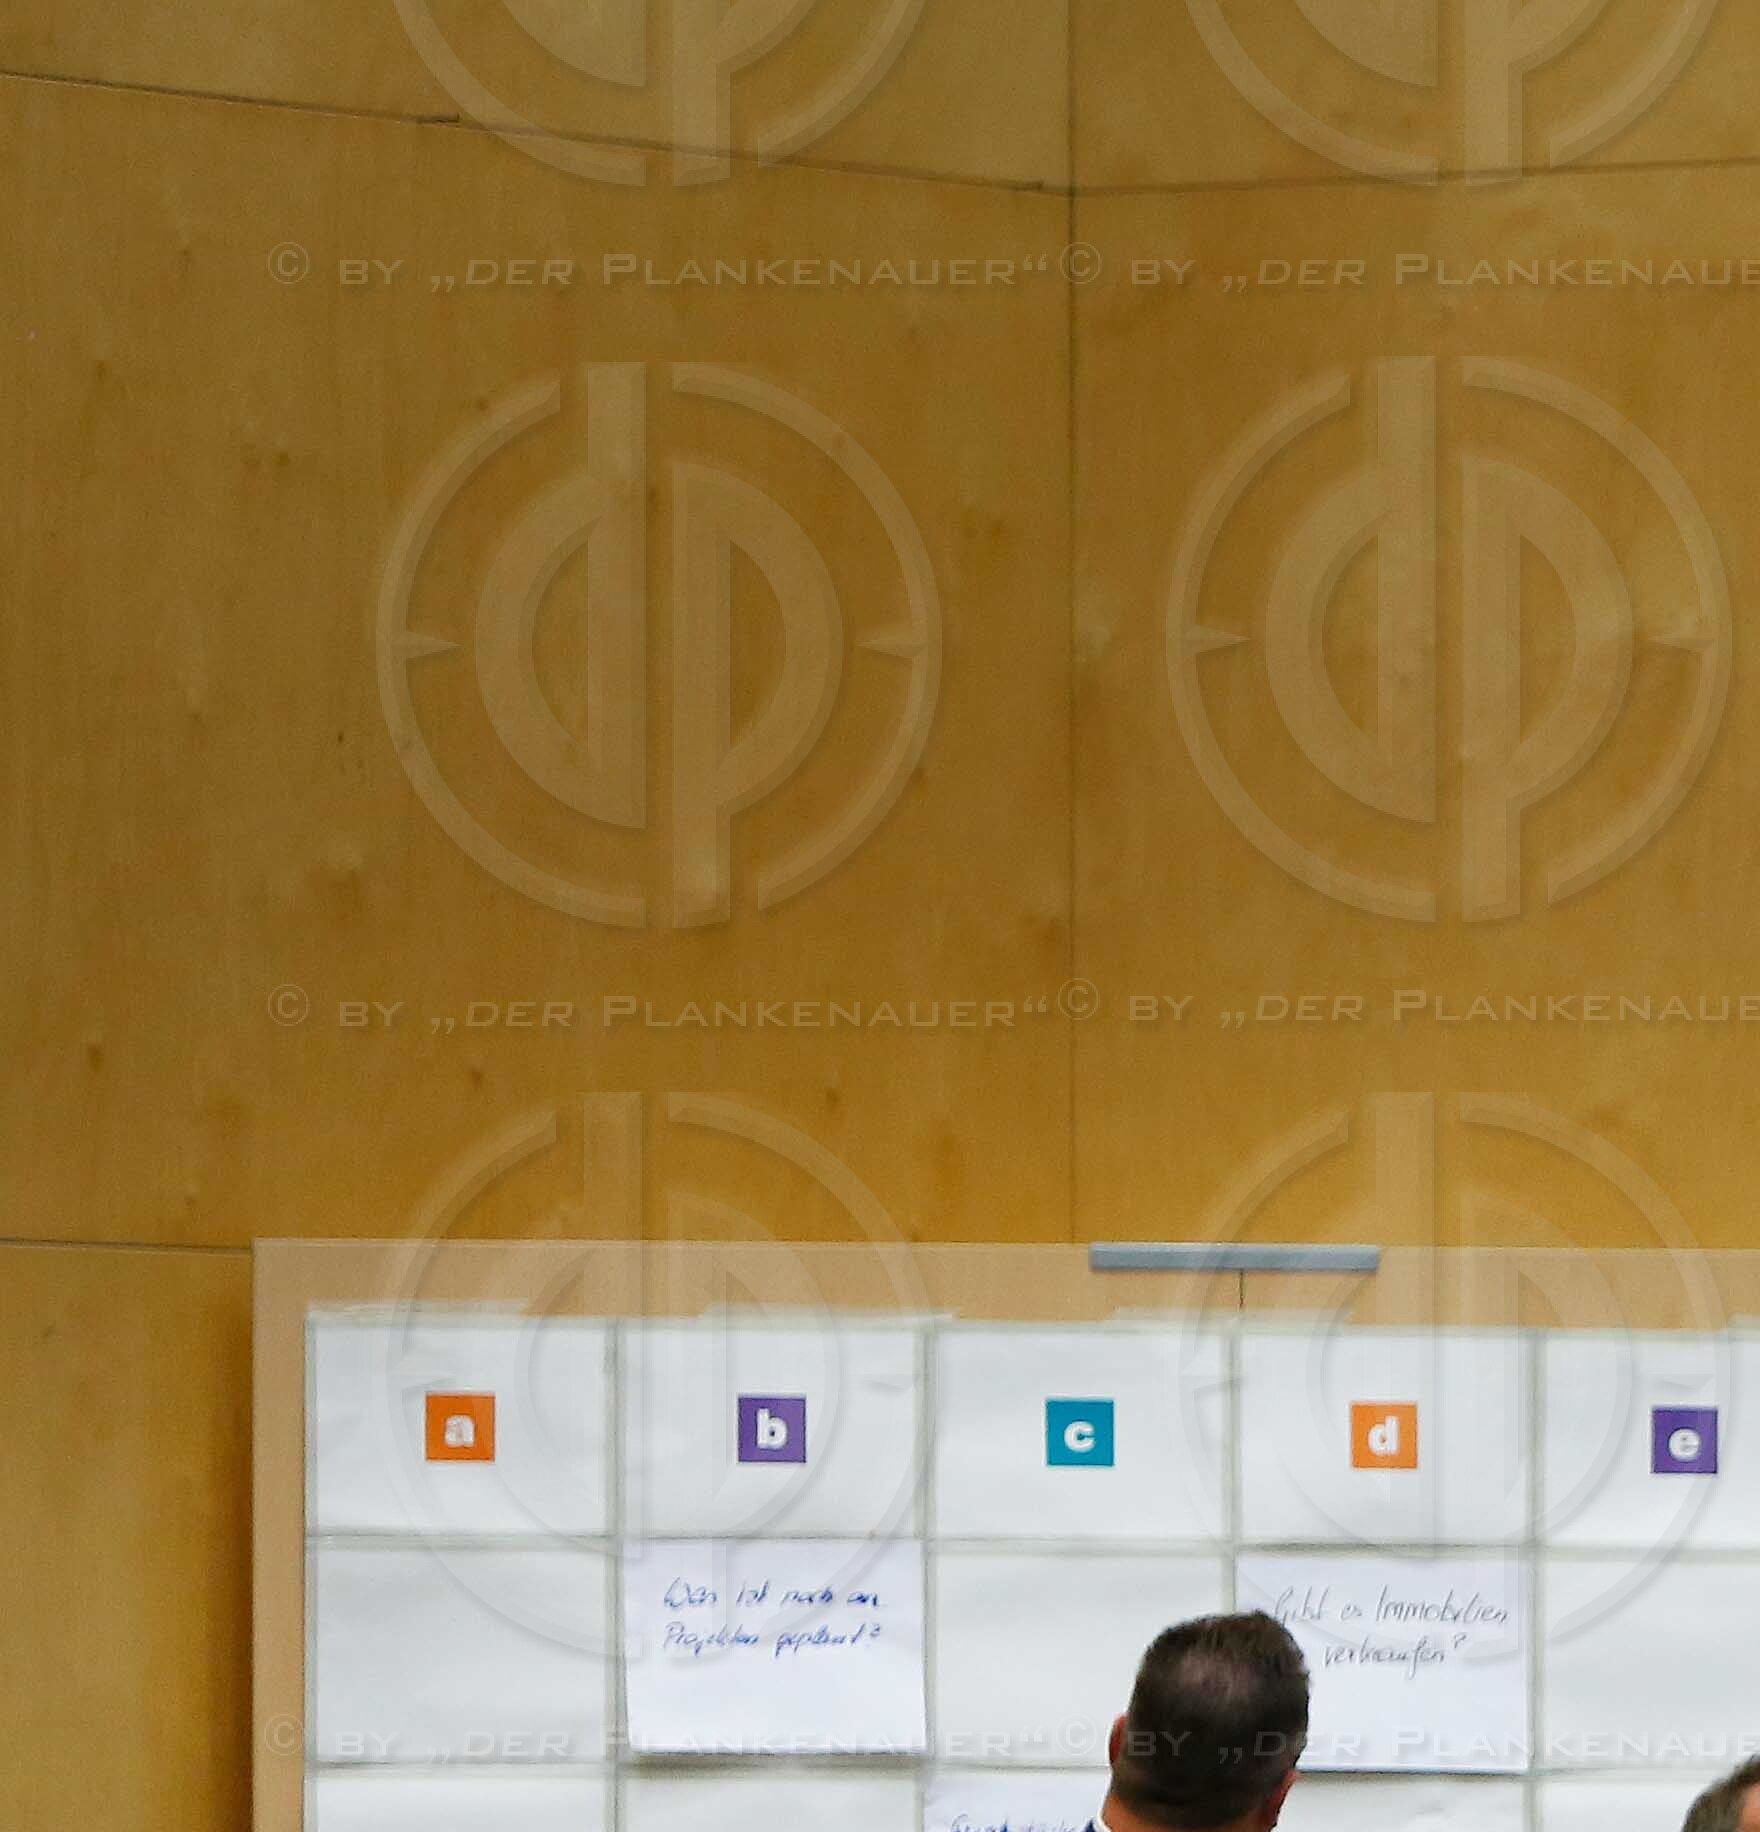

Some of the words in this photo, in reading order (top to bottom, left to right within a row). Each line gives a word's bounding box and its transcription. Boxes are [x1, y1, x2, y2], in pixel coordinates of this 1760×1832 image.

[444, 1414, 475, 1447] a
[757, 1408, 788, 1450] b
[1064, 1421, 1094, 1452] c
[1368, 1415, 1400, 1456] d
[1668, 1429, 1701, 1461] e
[1375, 1584, 1509, 1624] Immobilien
